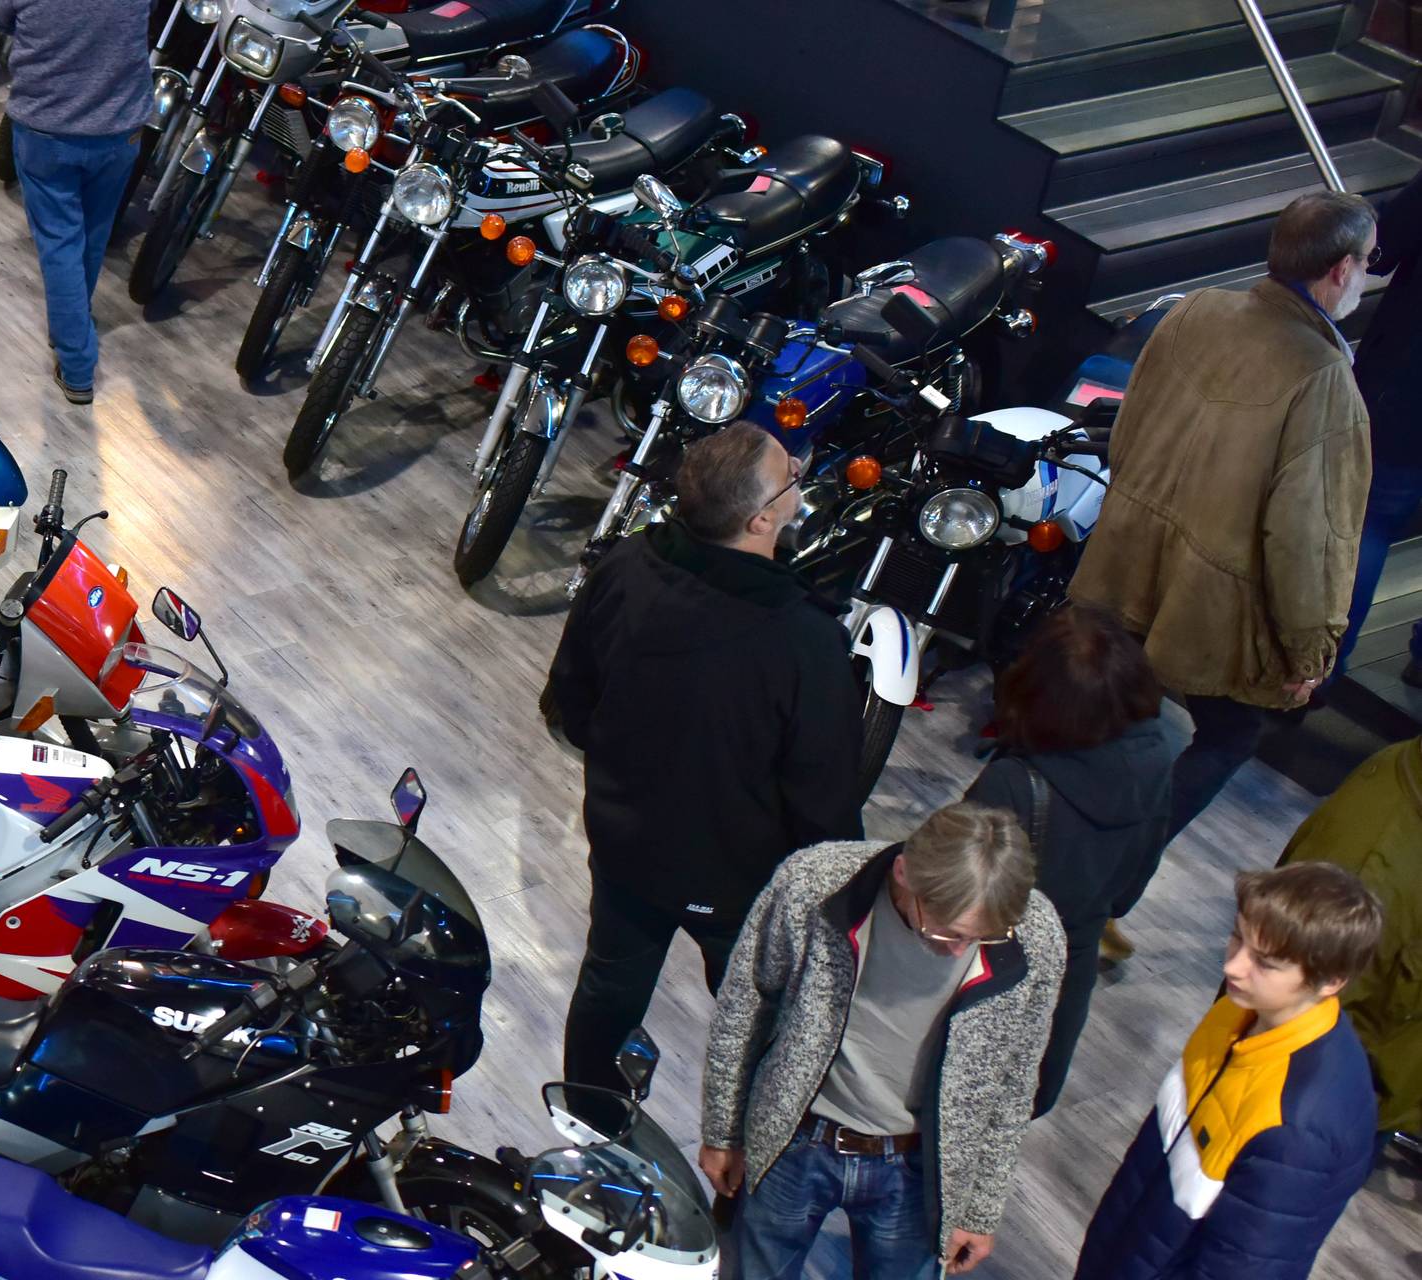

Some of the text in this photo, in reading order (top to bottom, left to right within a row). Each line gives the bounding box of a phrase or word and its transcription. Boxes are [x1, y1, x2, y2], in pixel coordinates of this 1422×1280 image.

[506, 179, 540, 194] Benelli
[128, 857, 250, 888] NS-1
[152, 1006, 262, 1047] SUZK
